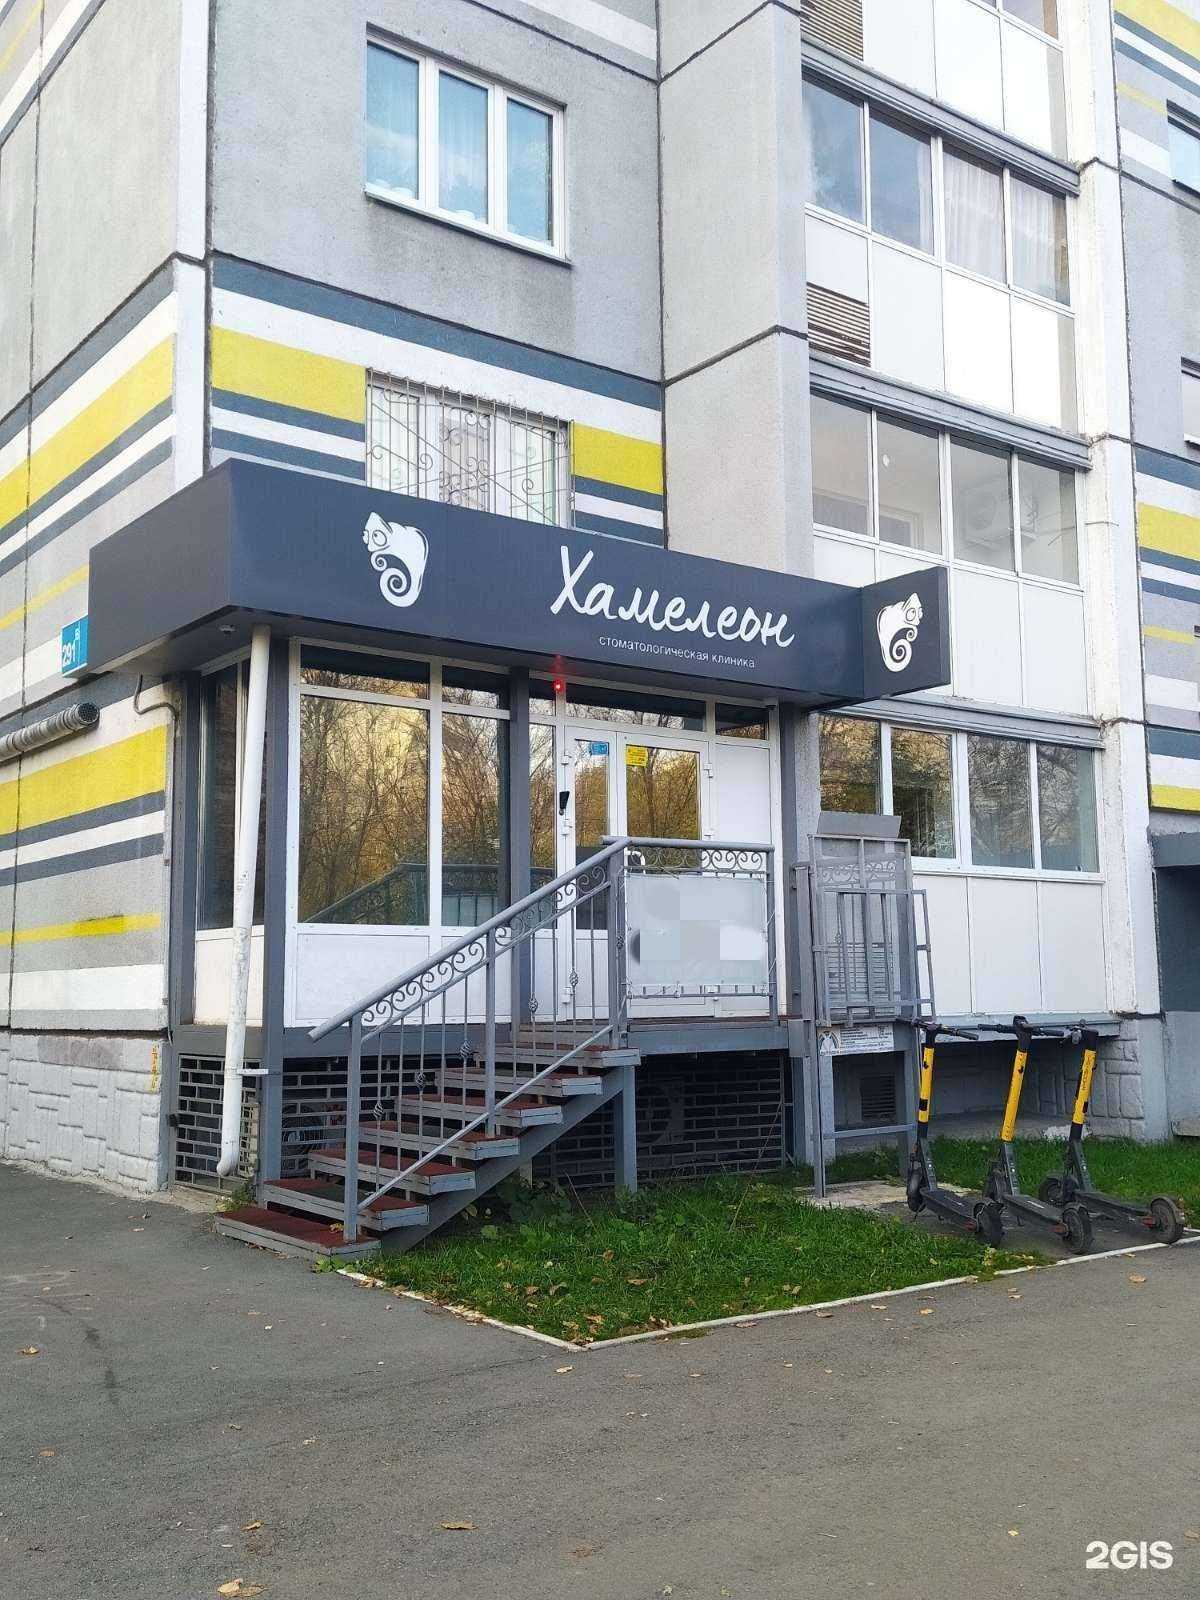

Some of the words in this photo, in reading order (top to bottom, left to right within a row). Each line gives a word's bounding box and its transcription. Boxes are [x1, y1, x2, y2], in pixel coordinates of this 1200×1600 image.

[550, 545, 795, 647] Хамелеон
[599, 636, 709, 661] стоматологическая
[711, 654, 755, 668] клиника
